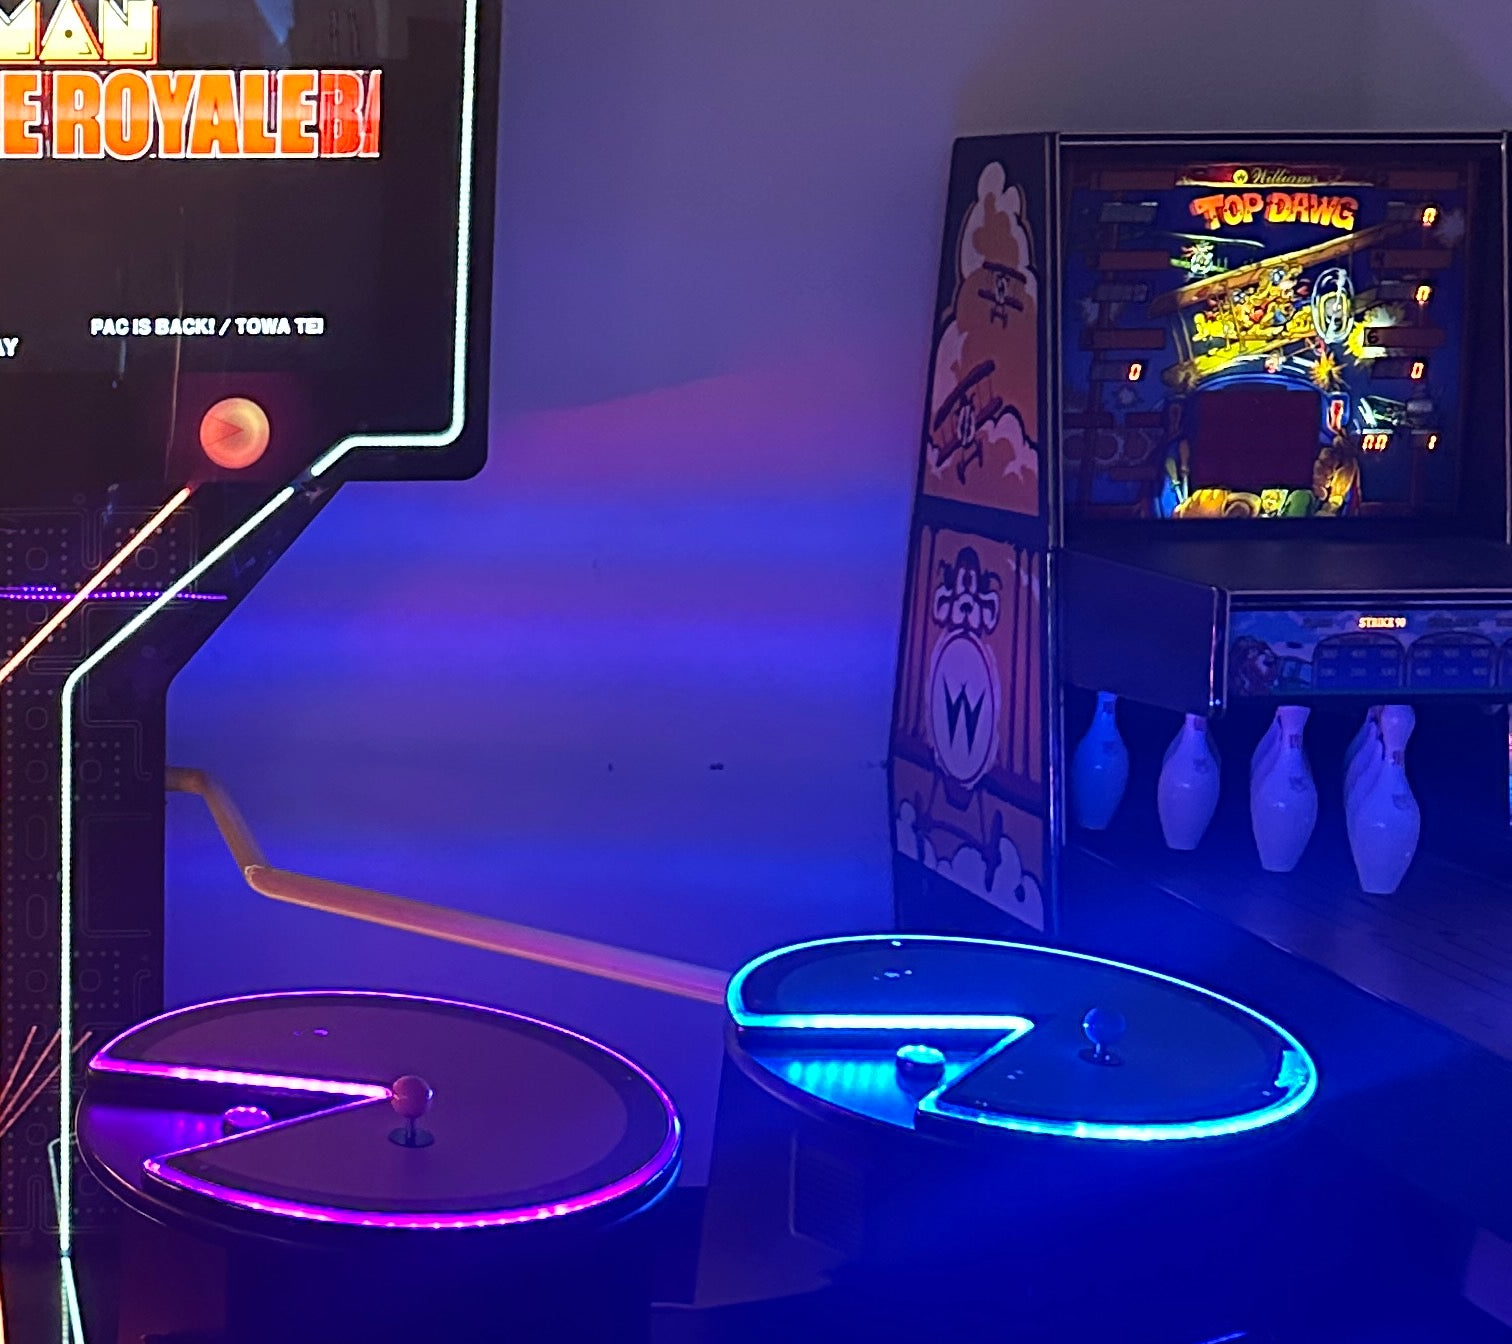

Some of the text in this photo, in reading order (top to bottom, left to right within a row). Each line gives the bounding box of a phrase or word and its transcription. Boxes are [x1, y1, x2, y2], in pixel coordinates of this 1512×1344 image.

[51, 69, 319, 160] ROYALE
[1251, 166, 1319, 185] Williams
[1189, 192, 1359, 231] TOP DAWG
[91, 317, 130, 335] PAC
[134, 318, 152, 335] IS
[155, 317, 215, 335] BACK!
[235, 317, 291, 335] TOWA
[1127, 360, 1143, 381] 0
[1410, 360, 1425, 380] 0
[943, 675, 986, 755] W
